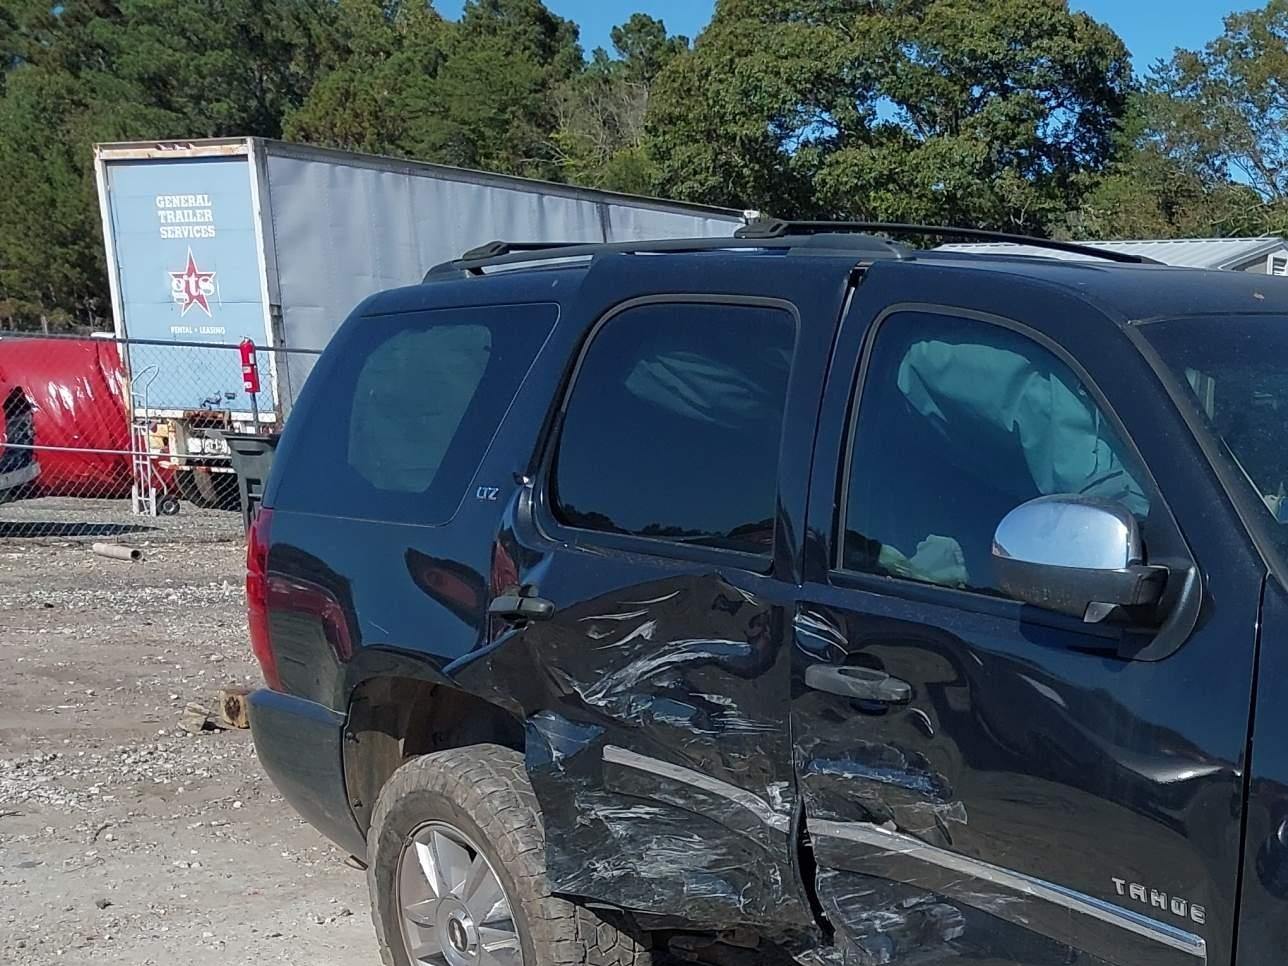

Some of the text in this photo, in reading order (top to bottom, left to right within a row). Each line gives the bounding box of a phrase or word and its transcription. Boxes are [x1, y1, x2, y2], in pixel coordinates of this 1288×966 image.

[156, 194, 212, 209] GENERAL
[158, 209, 213, 223] TRAILER
[160, 226, 216, 239] SERVICES
[171, 272, 215, 304] gts
[476, 486, 499, 501] LTZ
[1111, 876, 1206, 925] TAHOE
